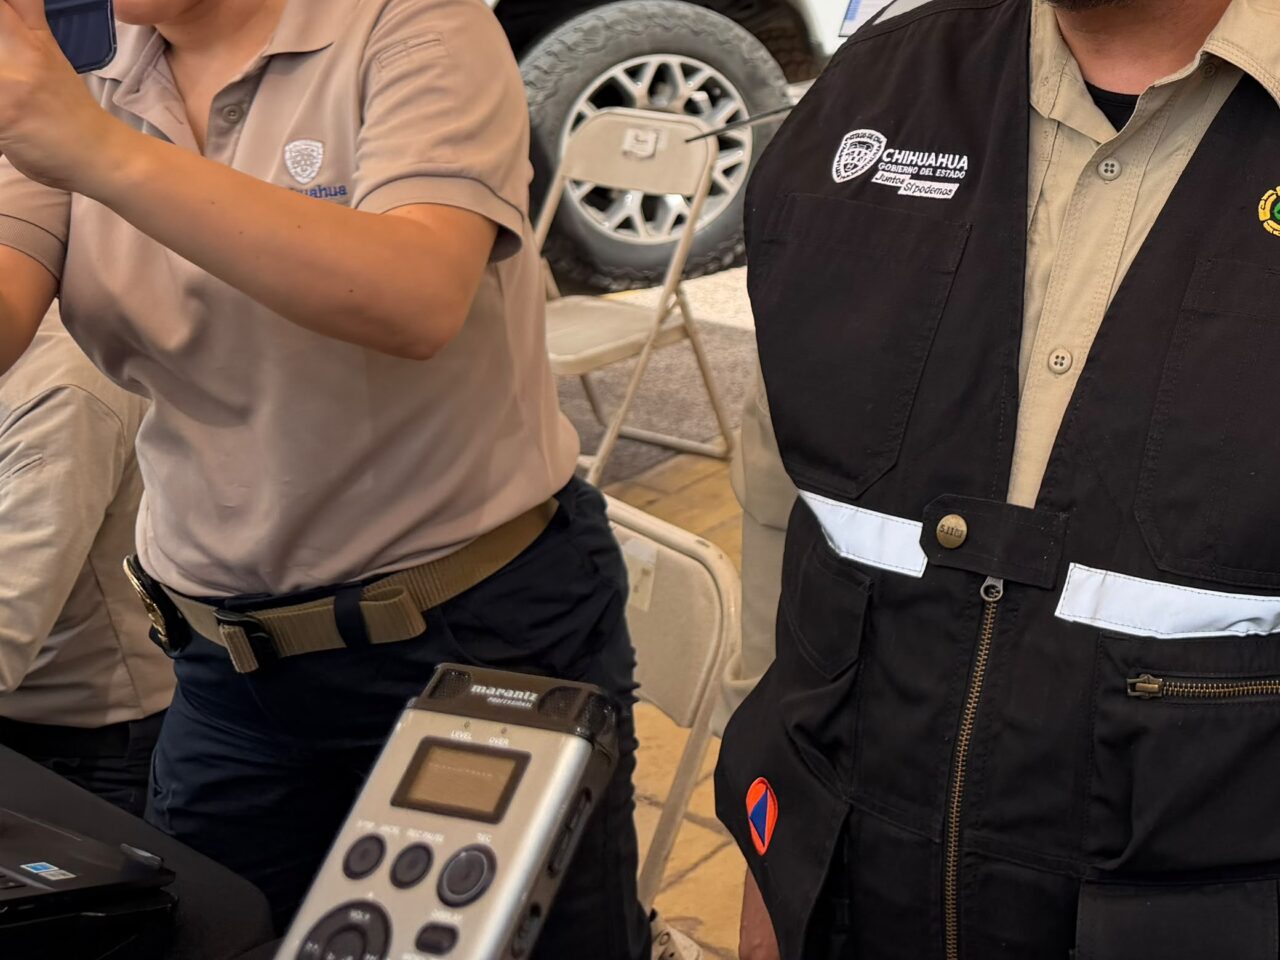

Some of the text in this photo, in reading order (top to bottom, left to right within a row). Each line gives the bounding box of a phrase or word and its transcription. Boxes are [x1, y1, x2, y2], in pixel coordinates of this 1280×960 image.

[882, 149, 968, 170] CHIHUAHUA
[878, 162, 966, 179] GOBIERNO DEL ESTADO
[912, 184, 953, 196] podemos
[470, 684, 539, 702] marantz
